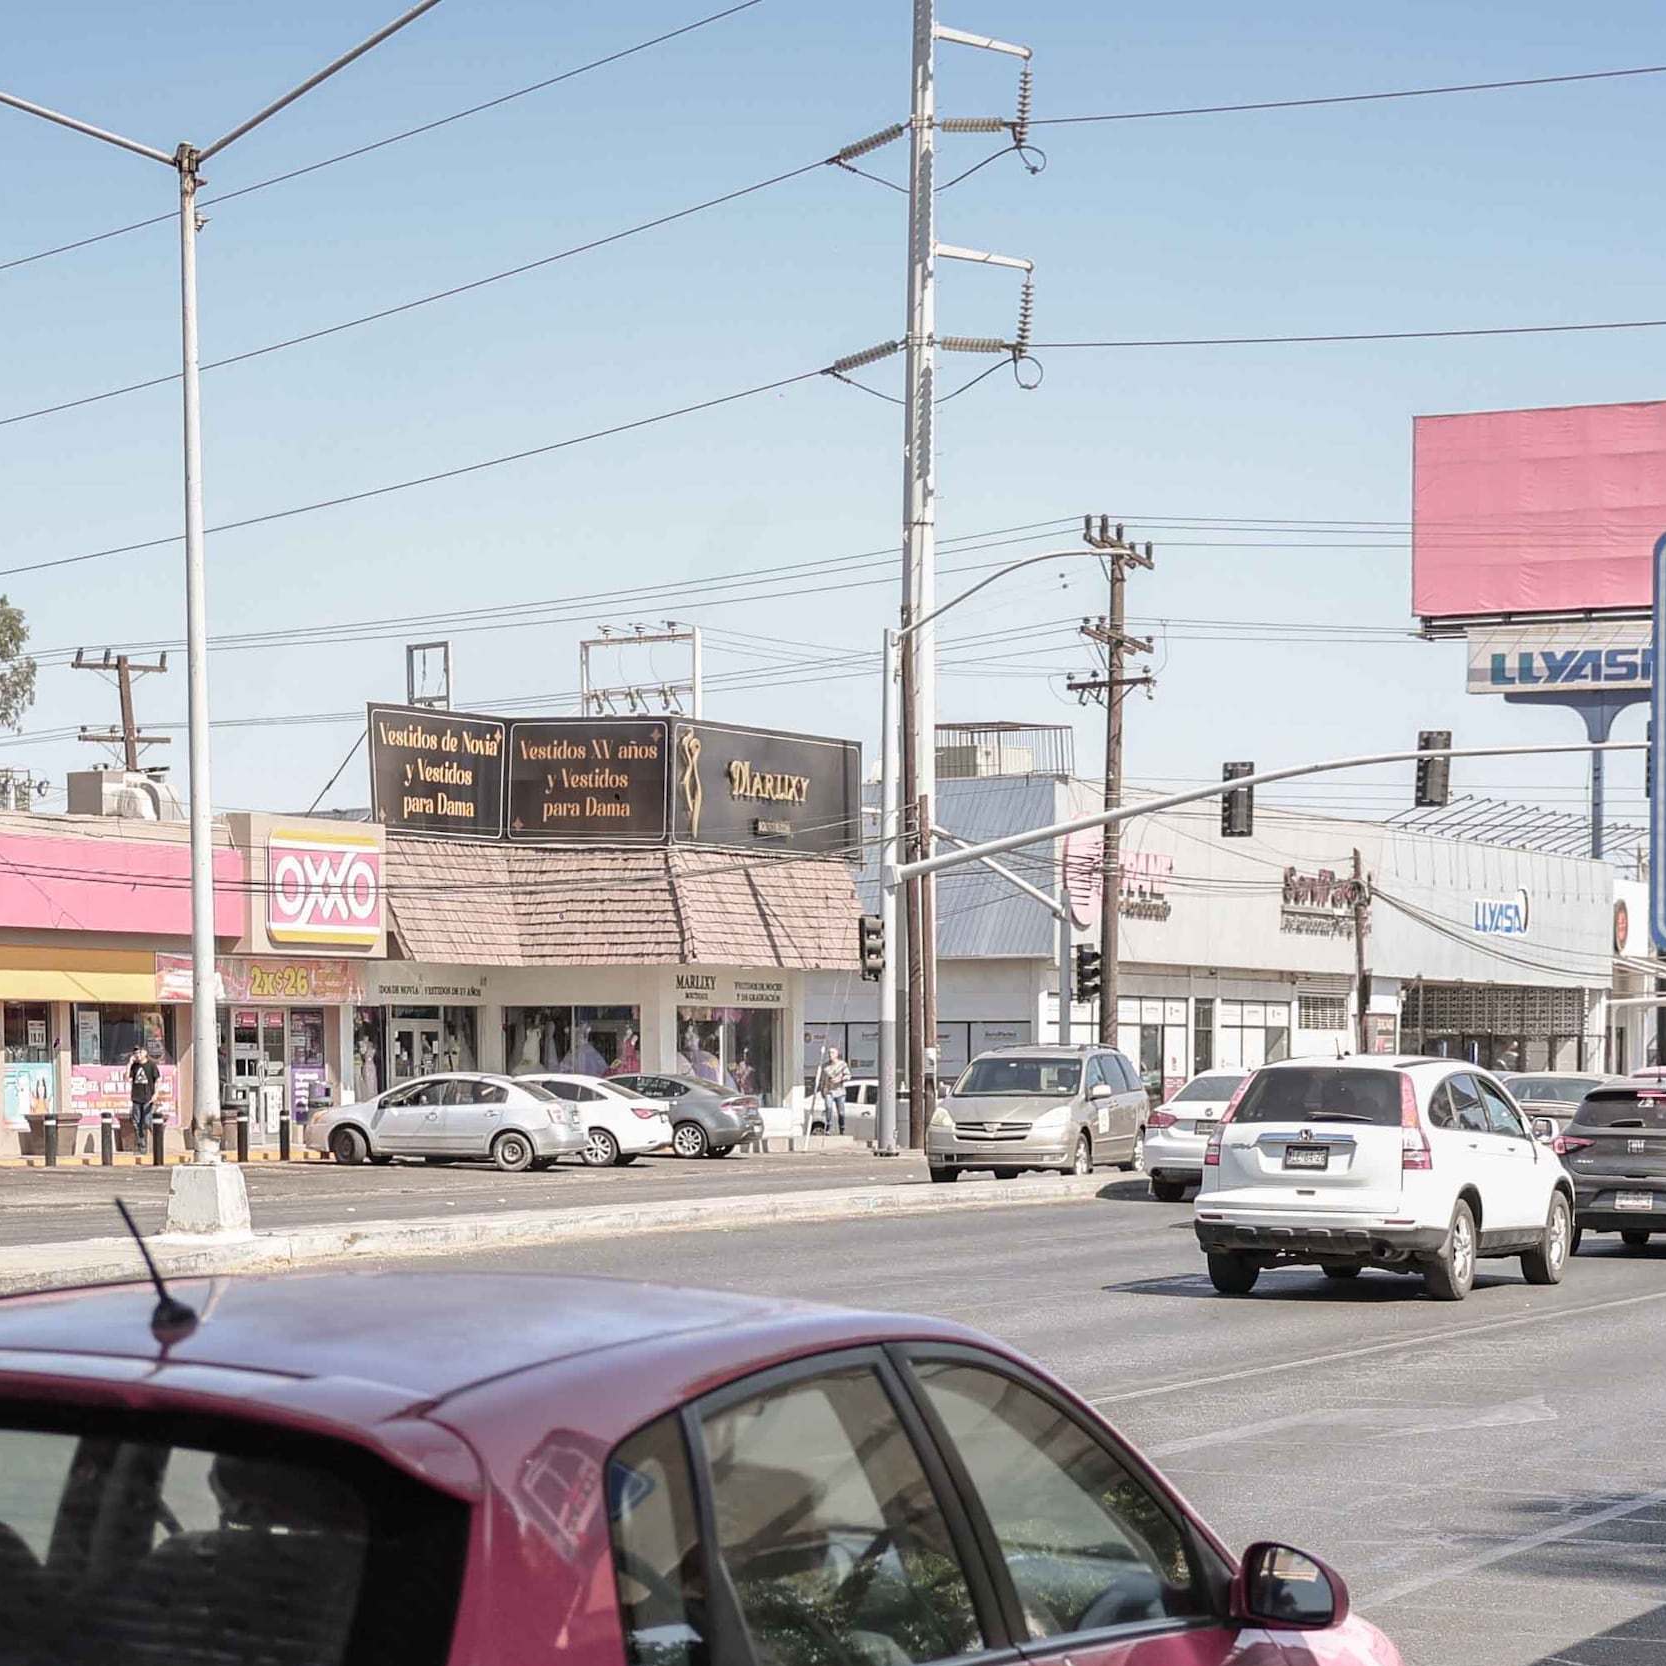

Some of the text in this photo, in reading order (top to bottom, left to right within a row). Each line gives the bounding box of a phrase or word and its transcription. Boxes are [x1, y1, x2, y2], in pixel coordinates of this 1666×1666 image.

[379, 722, 498, 756] Vestidos de Novia
[520, 740, 658, 760] Vestidos XV años
[404, 758, 473, 786] y Vestidos
[545, 768, 629, 794] y Vestidos
[403, 792, 475, 819] para Dama
[543, 797, 631, 822] para Dama
[275, 852, 376, 922] OXXO
[1475, 901, 1526, 934] LLYASA
[676, 975, 716, 990] MARLIXY
